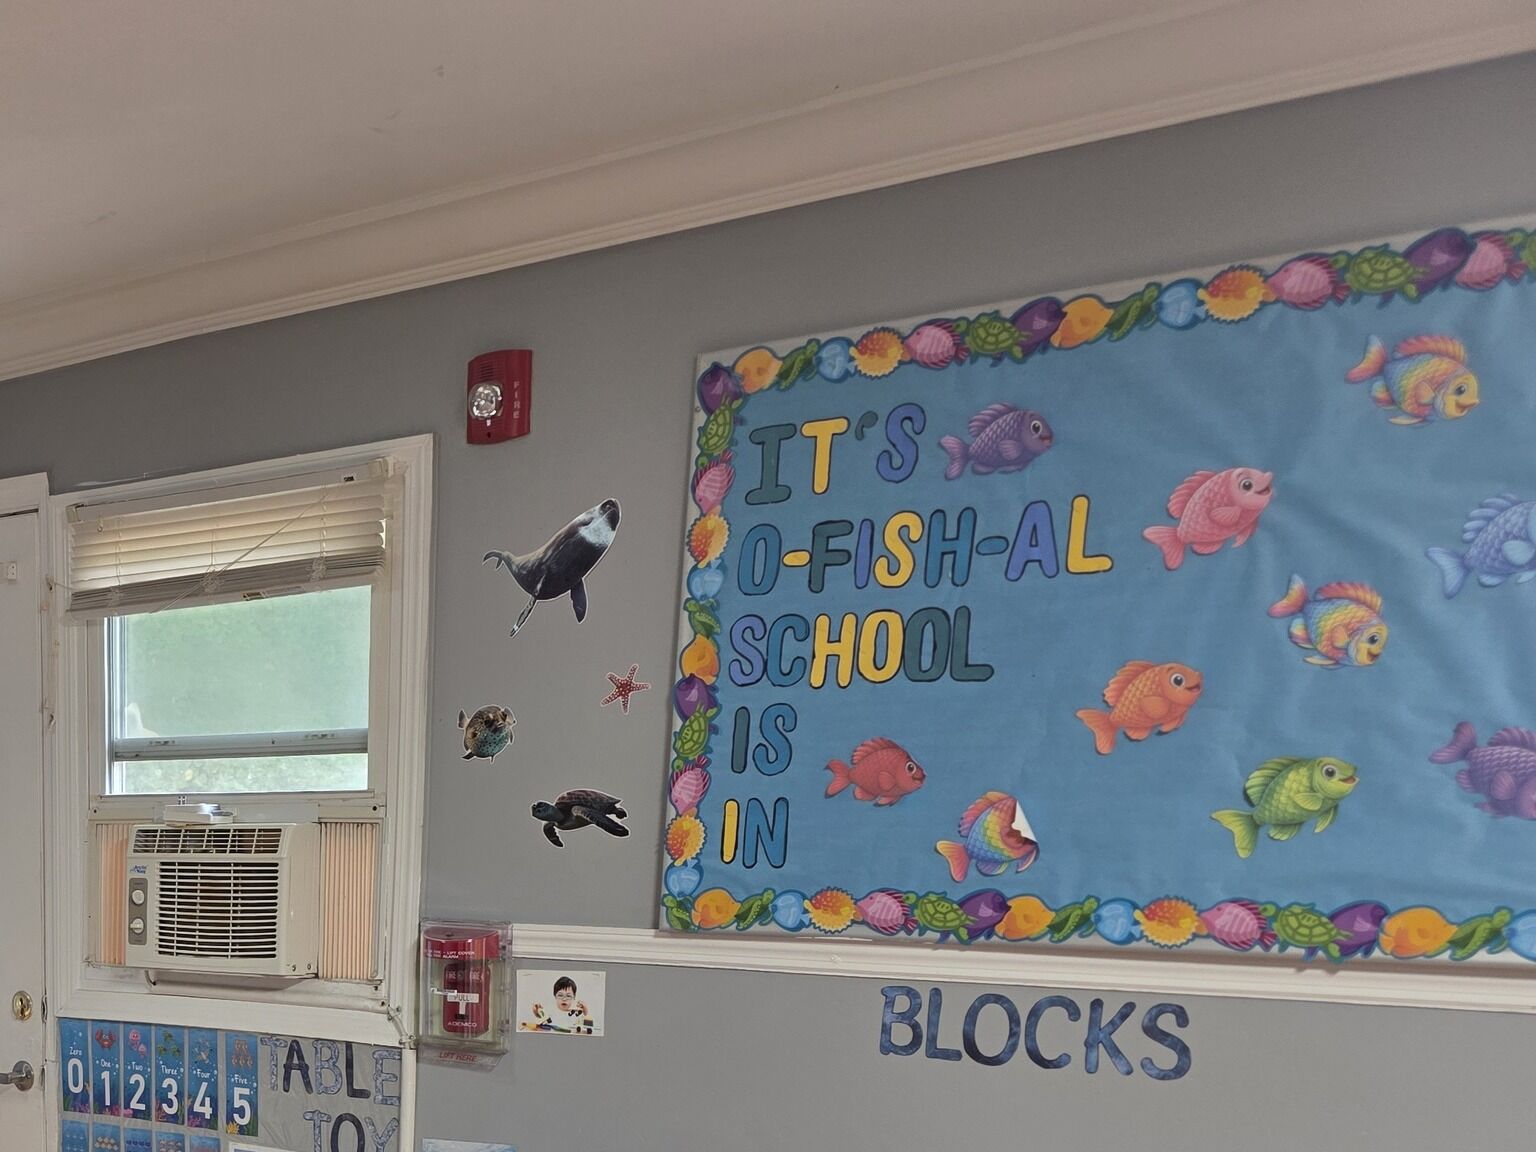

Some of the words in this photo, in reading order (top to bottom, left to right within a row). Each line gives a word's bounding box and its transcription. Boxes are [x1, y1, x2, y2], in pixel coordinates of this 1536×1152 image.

[511, 381, 521, 419] FIRE
[744, 402, 926, 505] IT'S
[737, 495, 1113, 597] O-FISH-AL
[728, 605, 995, 690] SCHOOL
[730, 702, 798, 776] IS
[720, 796, 789, 869] IN
[879, 986, 1192, 1081] BLOCKS
[100, 1058, 111, 1068] One
[131, 1061, 144, 1071] Two
[161, 1065, 178, 1076] Three
[197, 1068, 210, 1079] Four
[260, 1035, 401, 1106] TABLE
[439, 1051, 456, 1059] LIFT
[456, 1054, 478, 1062] HERE
[67, 1058, 84, 1094] 0
[101, 1070, 111, 1106] 1
[129, 1073, 146, 1111] 2
[234, 1074, 248, 1085] Five
[161, 1078, 179, 1115] 3
[193, 1082, 213, 1120] 4
[233, 1087, 251, 1126] 5
